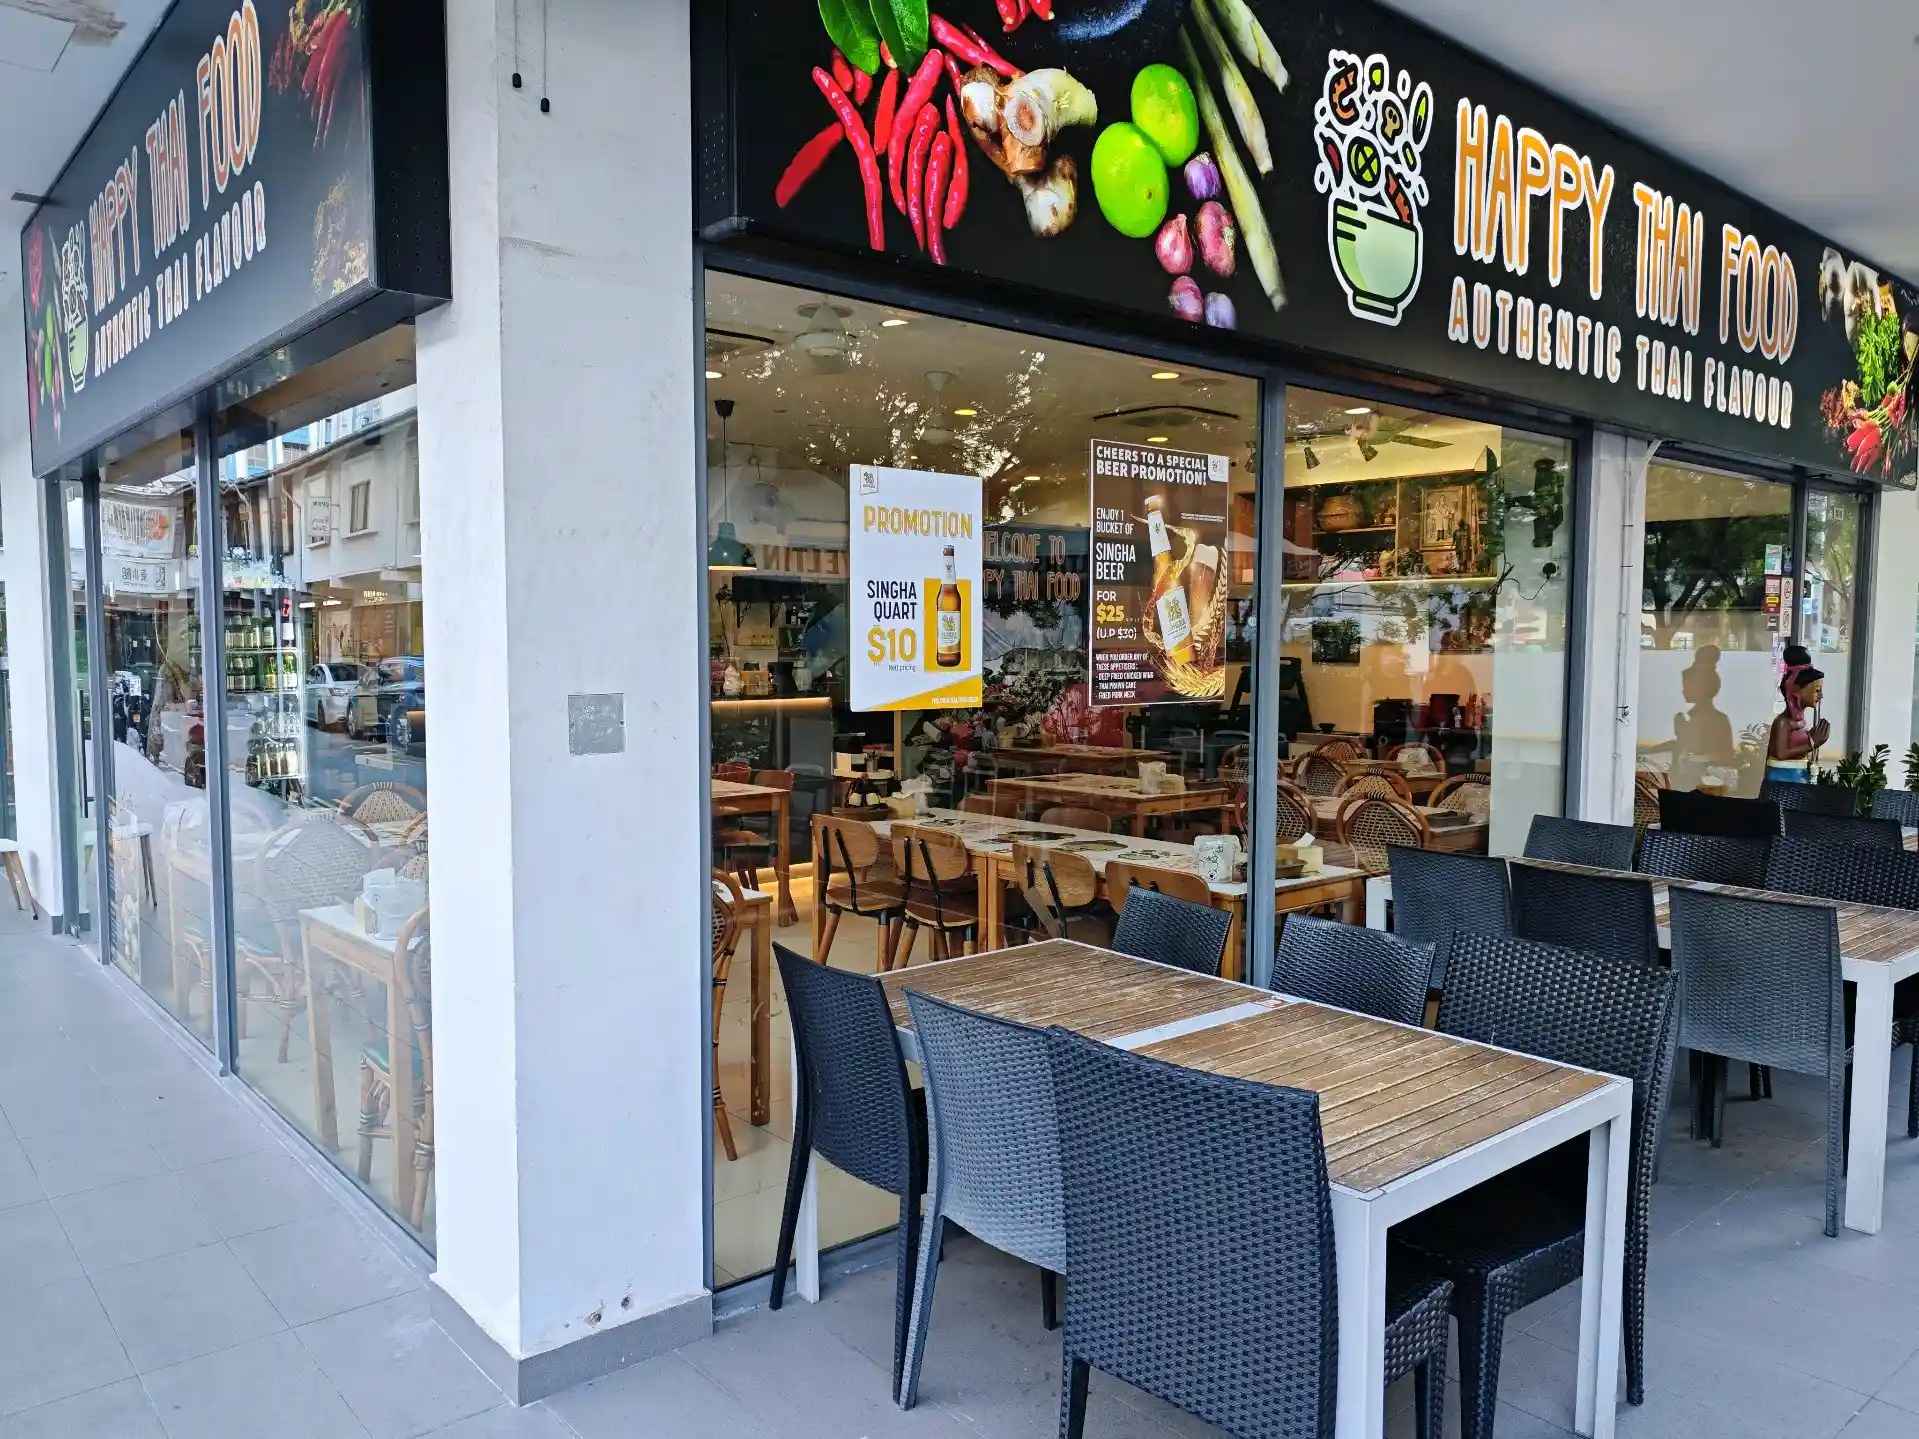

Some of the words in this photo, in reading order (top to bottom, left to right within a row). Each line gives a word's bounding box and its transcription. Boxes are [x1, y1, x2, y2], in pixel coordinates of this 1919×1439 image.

[88, 145, 140, 317] HAPPY
[145, 89, 190, 259] THAI
[196, 0, 261, 211] FOOD
[1454, 97, 1614, 300] HAPPY
[1633, 181, 1704, 336] THAI
[1719, 223, 1798, 364] FOOD
[95, 285, 151, 377] AUTHENTIC
[156, 253, 189, 329] THAI
[195, 180, 266, 301] FLAVOUR
[1448, 276, 1621, 383] AUTHENTIC
[1636, 335, 1692, 402] THAI
[1704, 357, 1793, 429] FLAVOUR
[1096, 445, 1138, 462] CHEERS
[1141, 451, 1154, 464] TO
[1157, 454, 1164, 466] A
[1166, 455, 1206, 470] SPECIAL
[1096, 460, 1128, 477] BEER
[1131, 464, 1206, 485] PROMOTION!
[863, 505, 973, 539] PROMOTION
[1096, 508, 1119, 521] ENJOY
[1121, 509, 1124, 521] 1
[1096, 522, 1124, 534] BUCKET
[1125, 523, 1134, 535] OF
[1048, 535, 1066, 564] TO
[1096, 543, 1136, 562] SINGHA
[1096, 562, 1124, 580] BEER
[867, 579, 917, 599] SINGHA
[1012, 570, 1039, 600] THAI
[1047, 571, 1081, 601] FOOD
[1096, 591, 1117, 601] FOR
[873, 601, 917, 620] QUART
[1096, 602, 1125, 624] $25
[867, 625, 917, 665] $10
[1096, 663, 1110, 671] THESE
[1098, 672, 1110, 681] DEEP
[1110, 672, 1124, 680] FRIED
[1124, 672, 1142, 680] CHICKEN
[1098, 682, 1109, 690] THAI
[1109, 682, 1125, 690] PRAWN
[1098, 691, 1111, 699] FRIED
